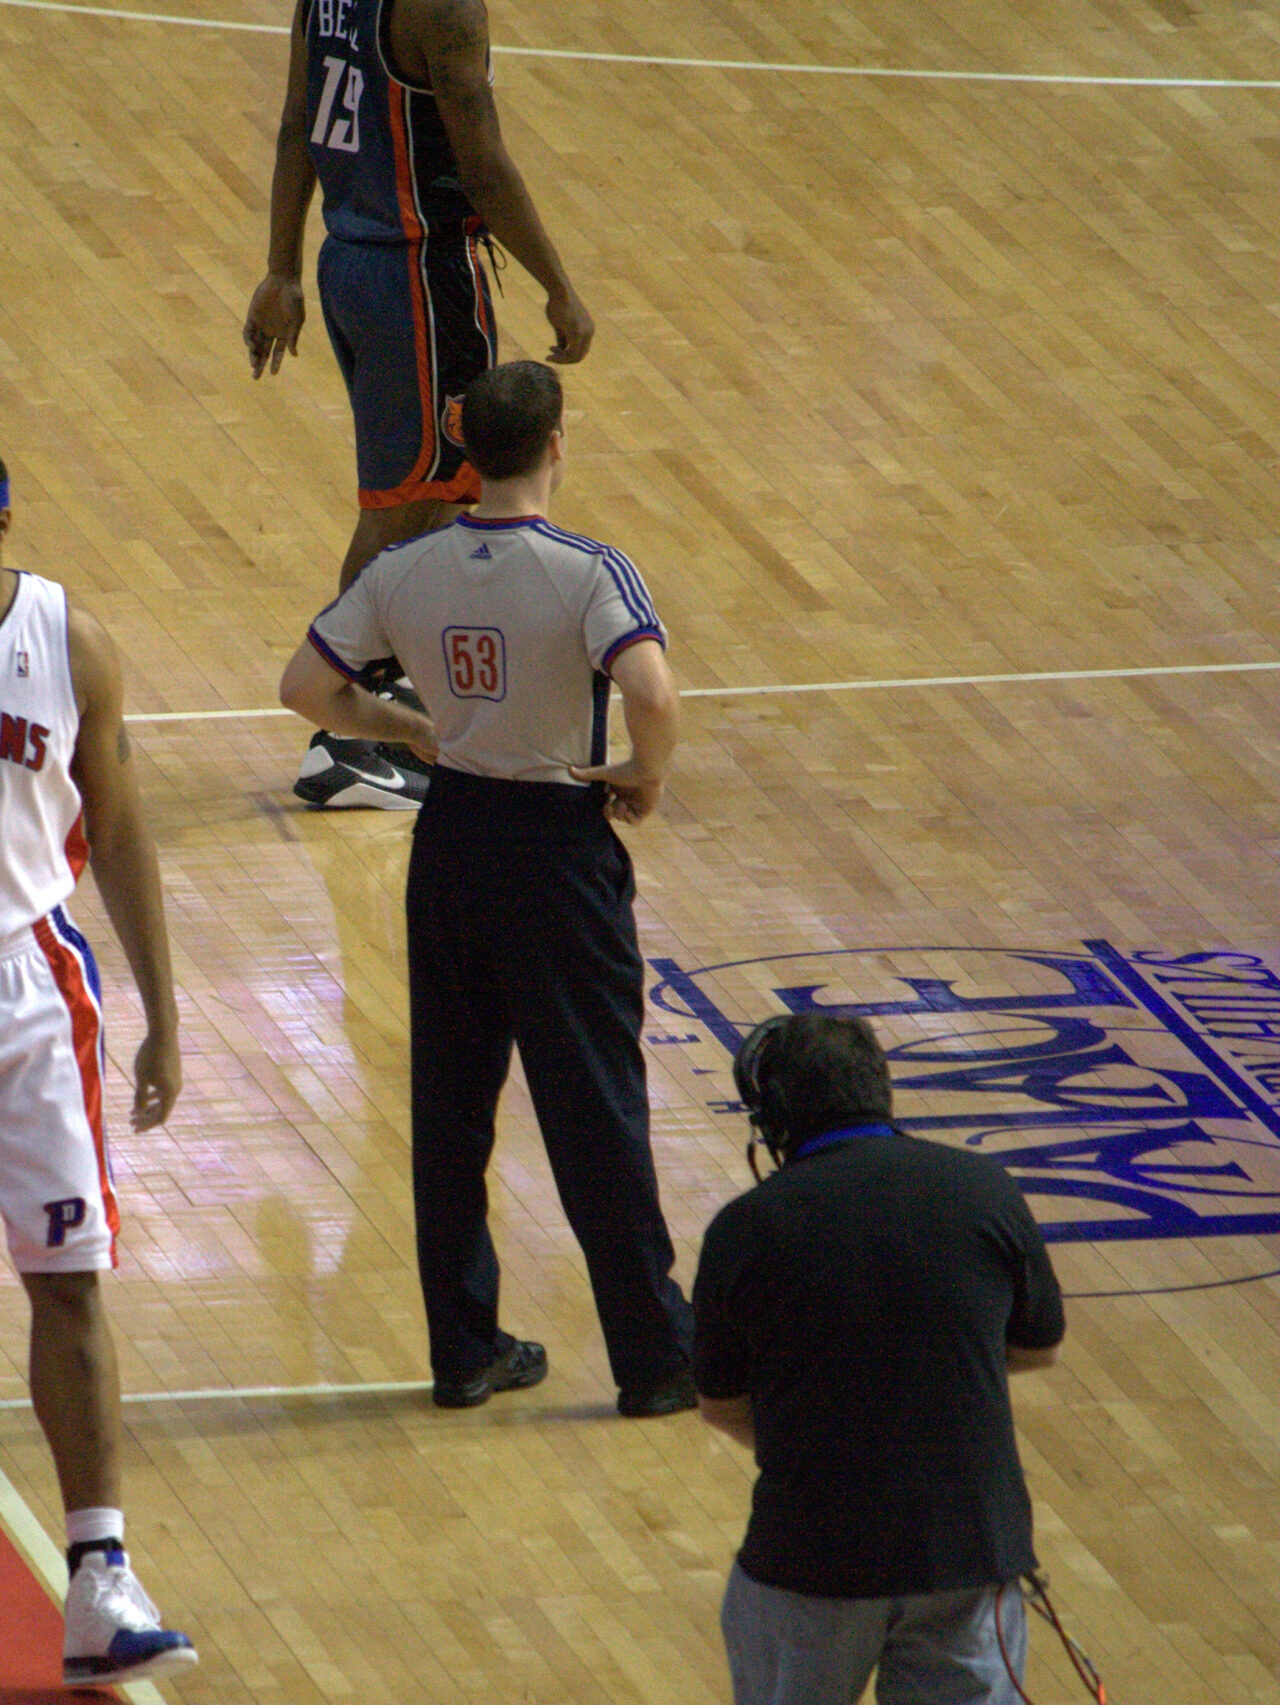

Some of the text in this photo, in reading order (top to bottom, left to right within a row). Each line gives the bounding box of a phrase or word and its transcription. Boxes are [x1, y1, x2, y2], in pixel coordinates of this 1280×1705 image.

[310, 55, 364, 152] 19
[452, 635, 498, 691] 53
[43, 1197, 86, 1248] P
